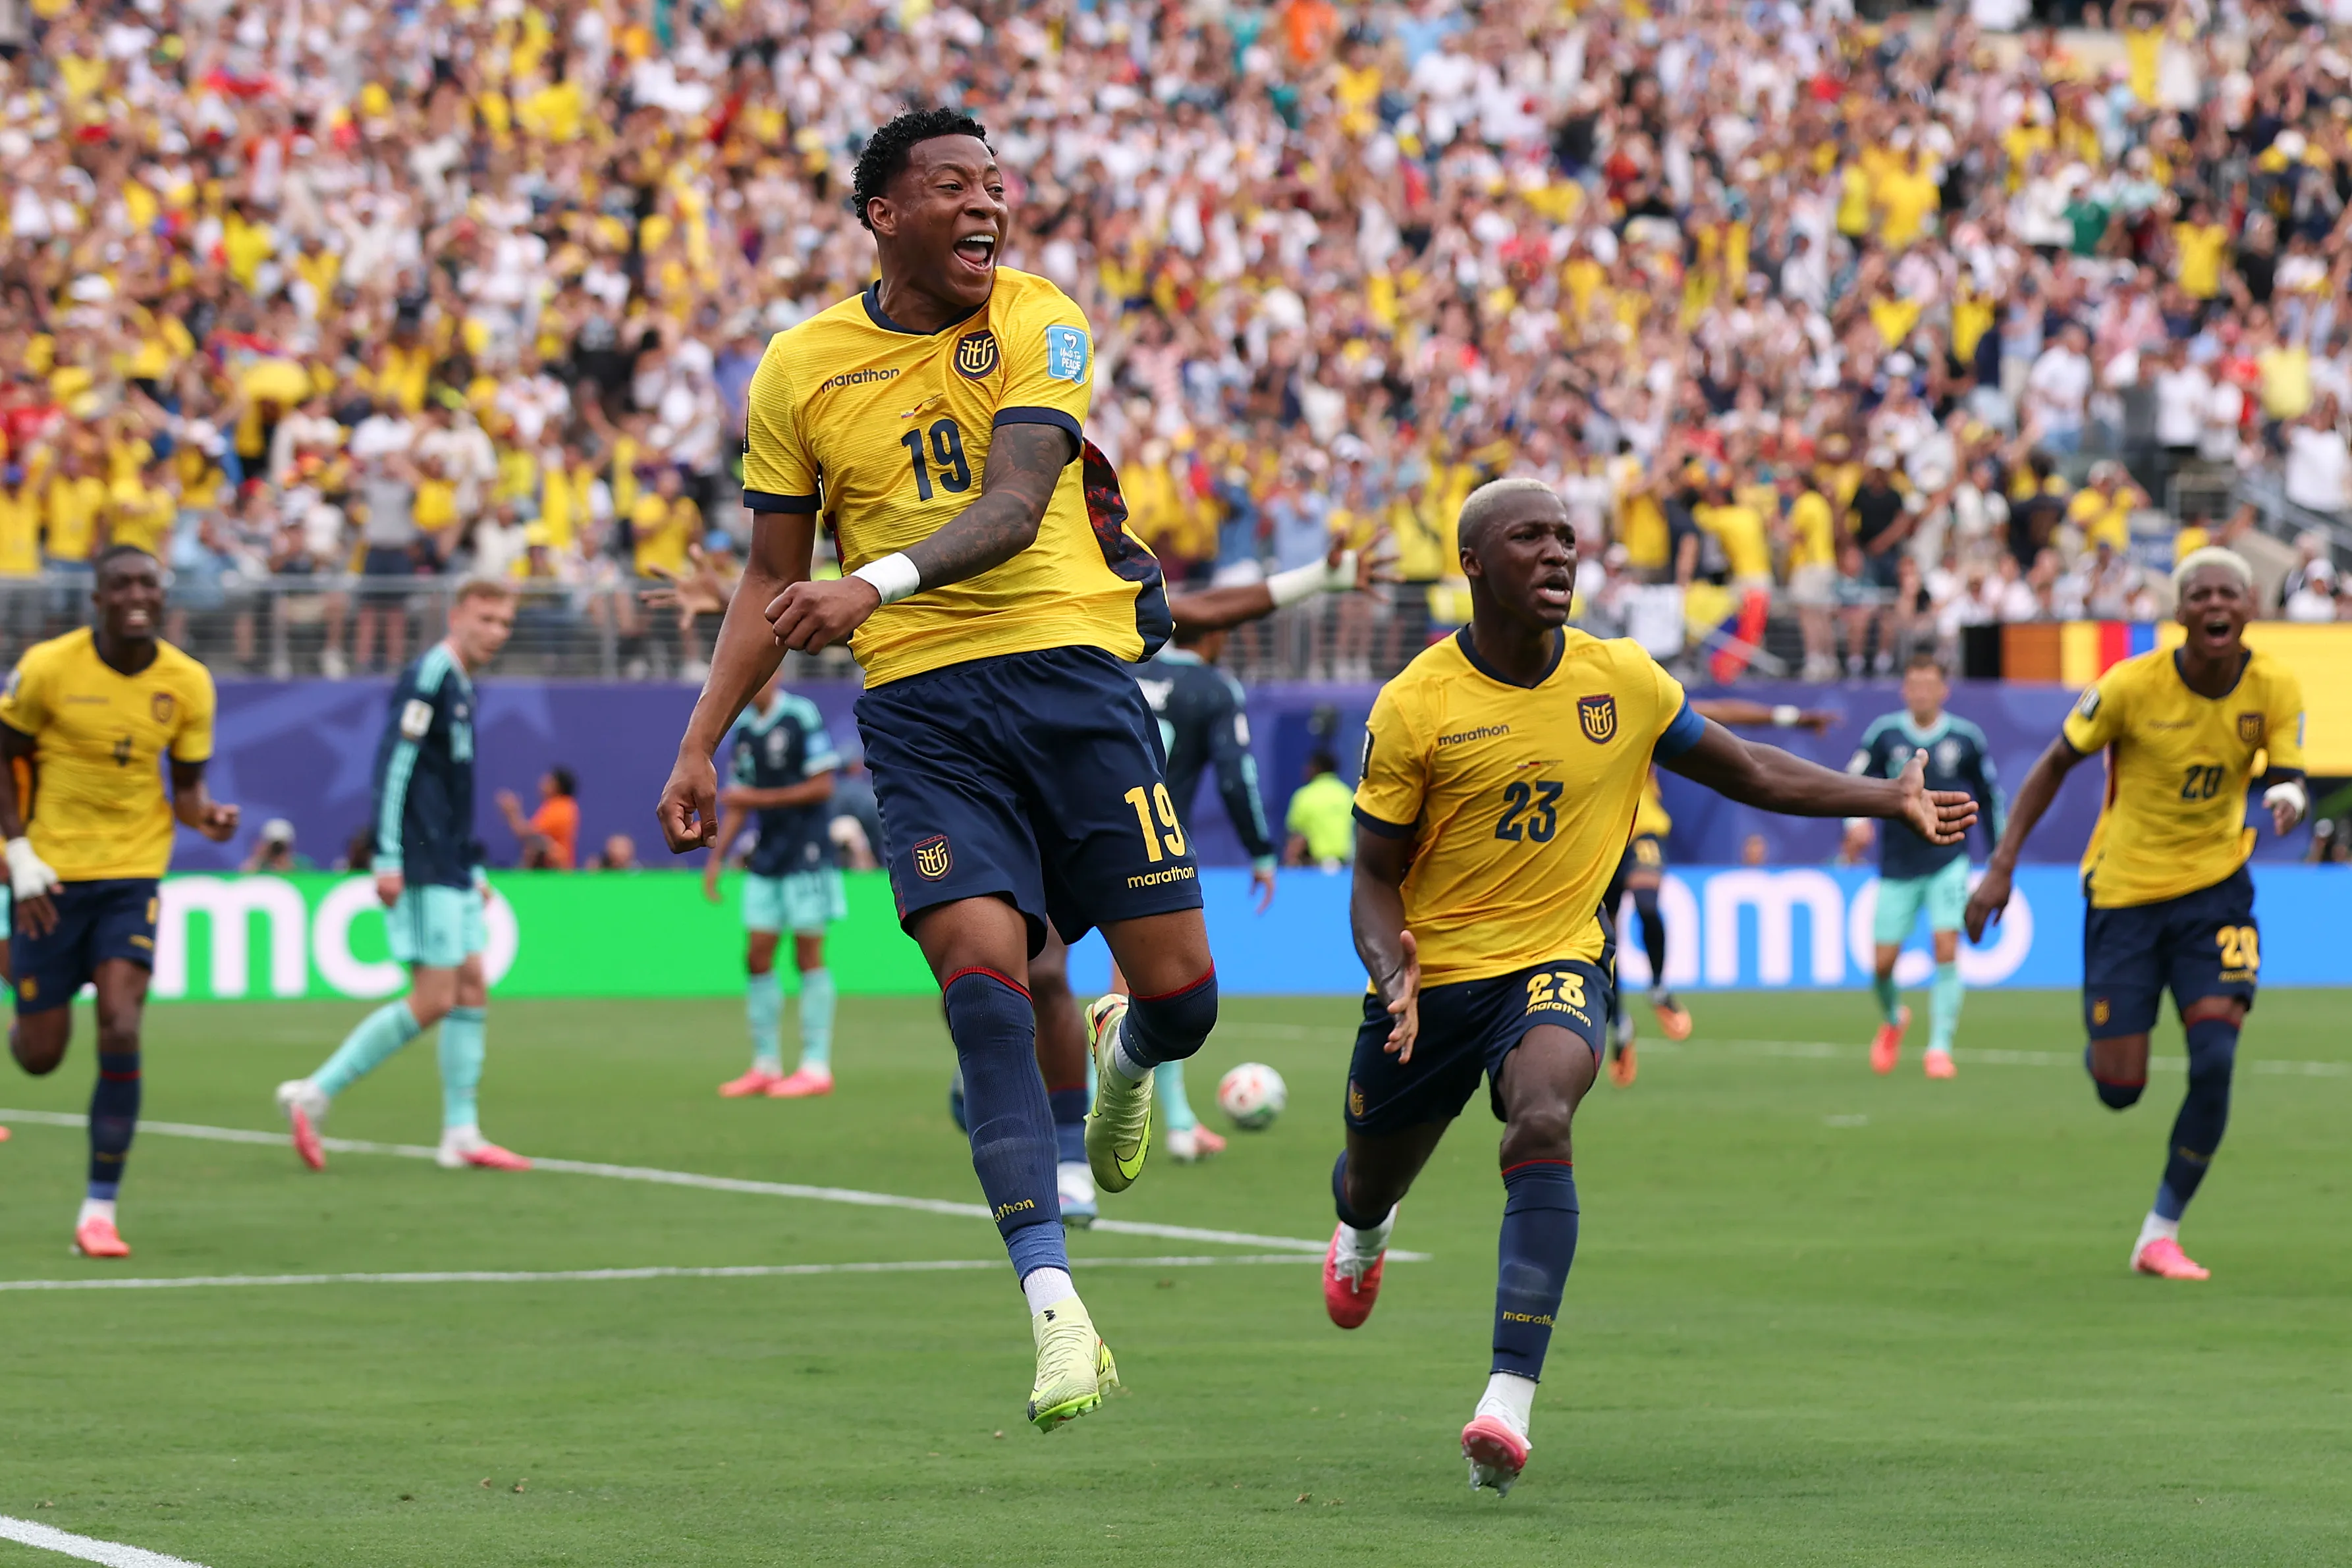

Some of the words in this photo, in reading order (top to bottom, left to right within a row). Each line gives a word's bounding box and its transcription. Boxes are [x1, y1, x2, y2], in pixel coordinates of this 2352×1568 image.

[1061, 358, 1081, 370] PEACE
[821, 367, 900, 393] marathon
[901, 419, 971, 502] 19
[1438, 724, 1510, 745] marathon
[2181, 764, 2225, 801] 20
[1124, 782, 1186, 862] 19
[1495, 780, 1564, 842] 23
[1128, 865, 1195, 888] marathon
[1526, 971, 1586, 1008] 23
[1525, 1001, 1591, 1027] marathon
